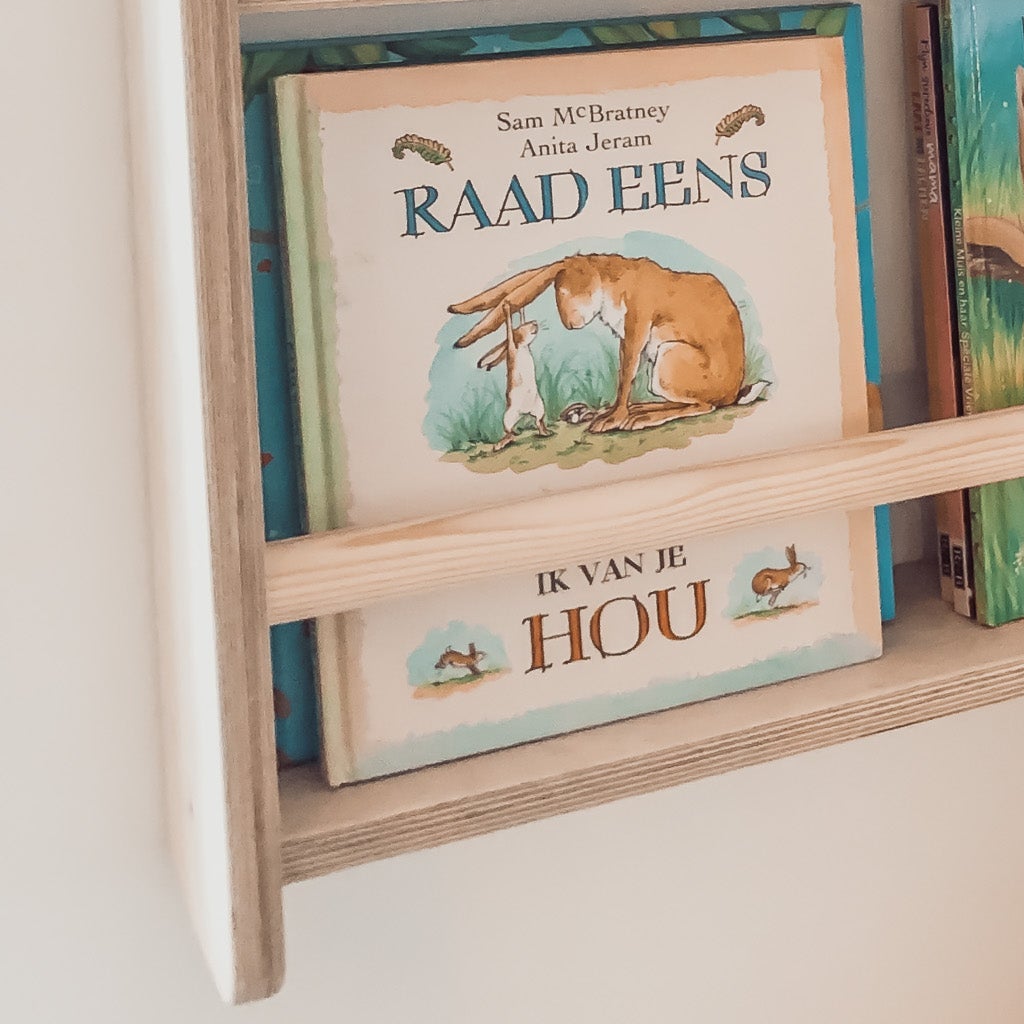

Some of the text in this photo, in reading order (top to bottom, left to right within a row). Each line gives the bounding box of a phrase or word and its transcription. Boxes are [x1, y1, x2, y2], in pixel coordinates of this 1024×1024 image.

[496, 103, 670, 132] Sam McBratney
[520, 132, 652, 159] Anita Jeram
[393, 151, 772, 239] RAAD EENS
[926, 142, 939, 204] mama
[535, 544, 687, 596] IK VAN JE
[522, 579, 711, 674] HOU
